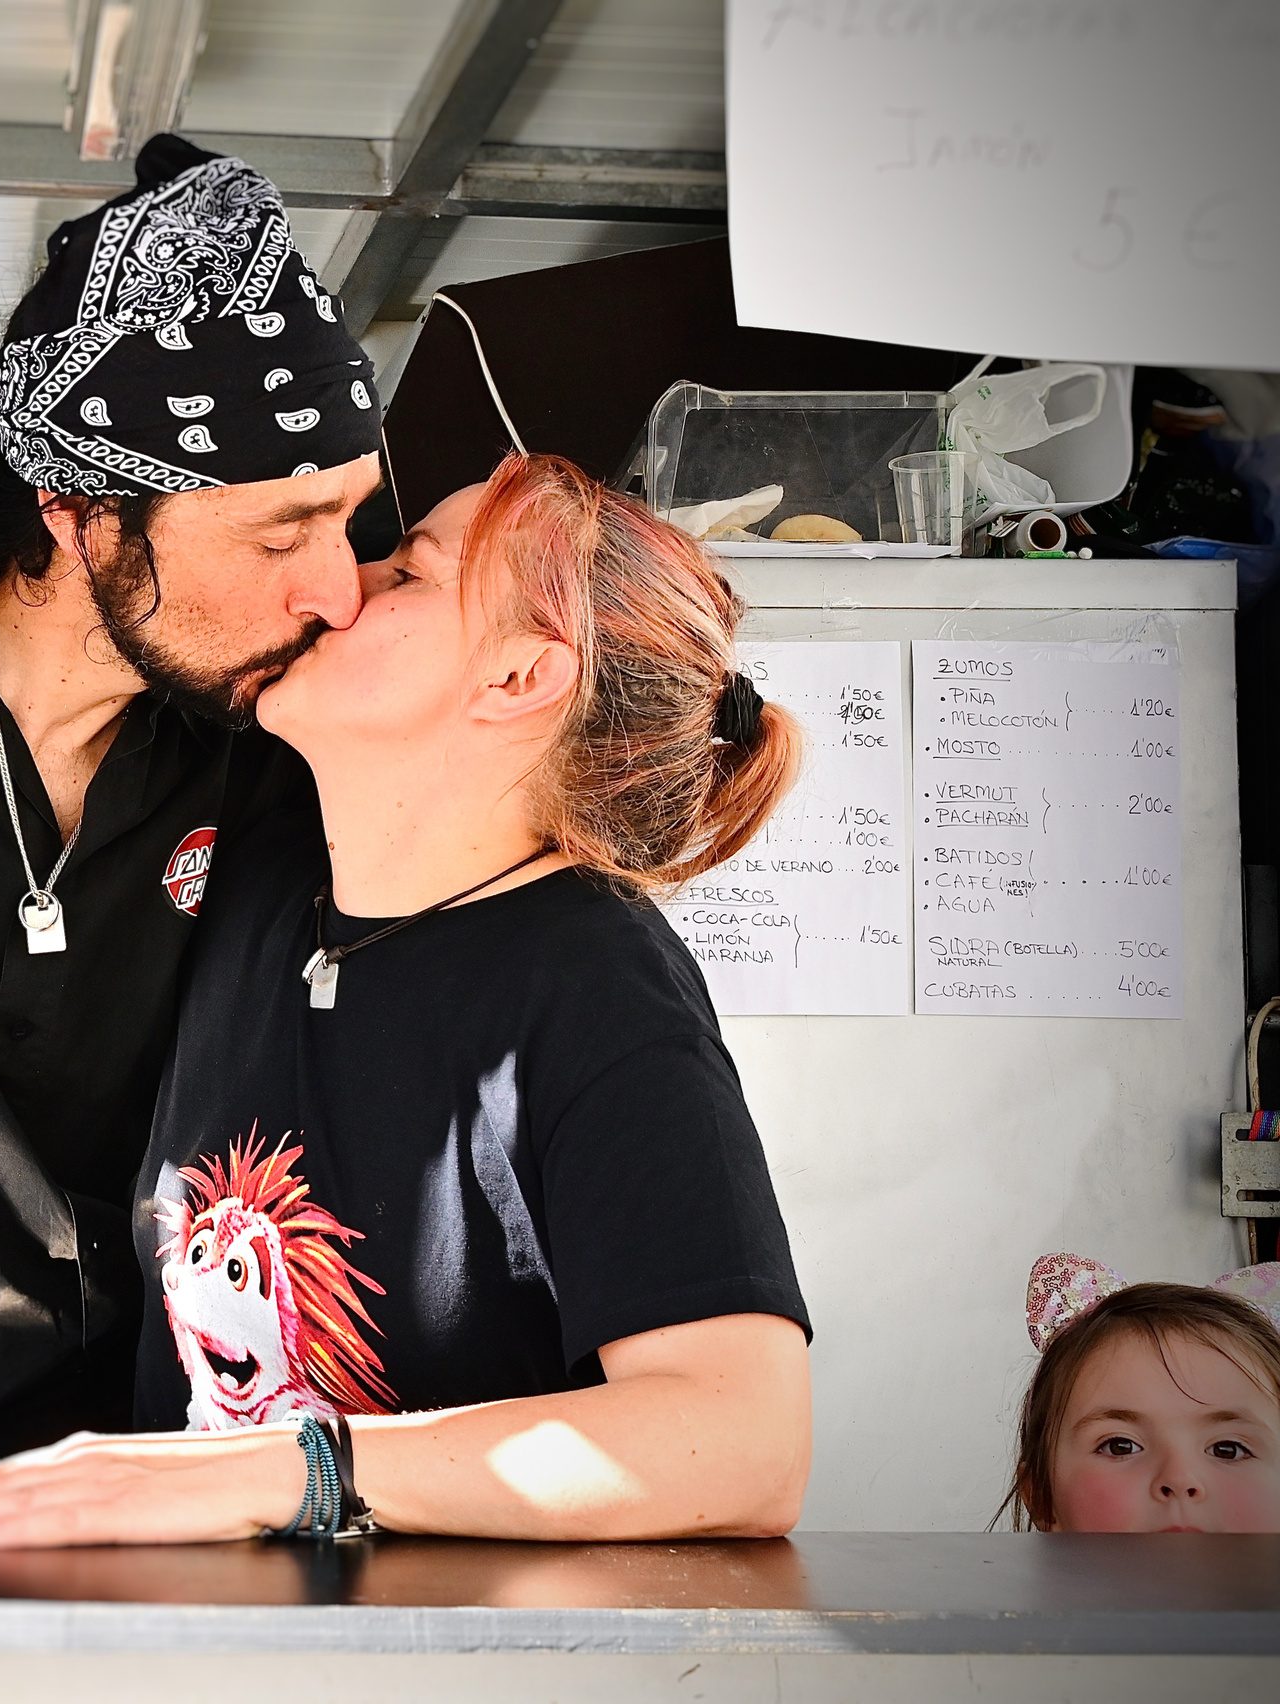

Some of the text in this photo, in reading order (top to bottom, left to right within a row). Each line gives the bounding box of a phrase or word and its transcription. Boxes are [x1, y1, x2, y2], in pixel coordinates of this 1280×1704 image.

[938, 659, 1013, 676] ZUMOS
[949, 687, 995, 705] PIÑA
[951, 709, 1058, 728] MELOCOTÓN
[937, 737, 1001, 755] MOSTO
[935, 781, 1018, 801] VERMUT
[937, 806, 1029, 824] PACHARÁN
[934, 848, 1023, 865] BATIDOS
[746, 859, 767, 872] DE
[770, 859, 833, 874] VERANO
[935, 868, 997, 890] CAFÉ
[672, 887, 775, 903] FRESCOS
[937, 895, 996, 913] AGUA
[692, 910, 791, 927] COCA-COLA
[695, 929, 750, 945] LIMÓN
[928, 936, 1000, 956] SIDRA
[693, 948, 774, 963] NARANJA
[937, 957, 1003, 968] NATURAL
[924, 982, 1017, 999] CUBATAS
